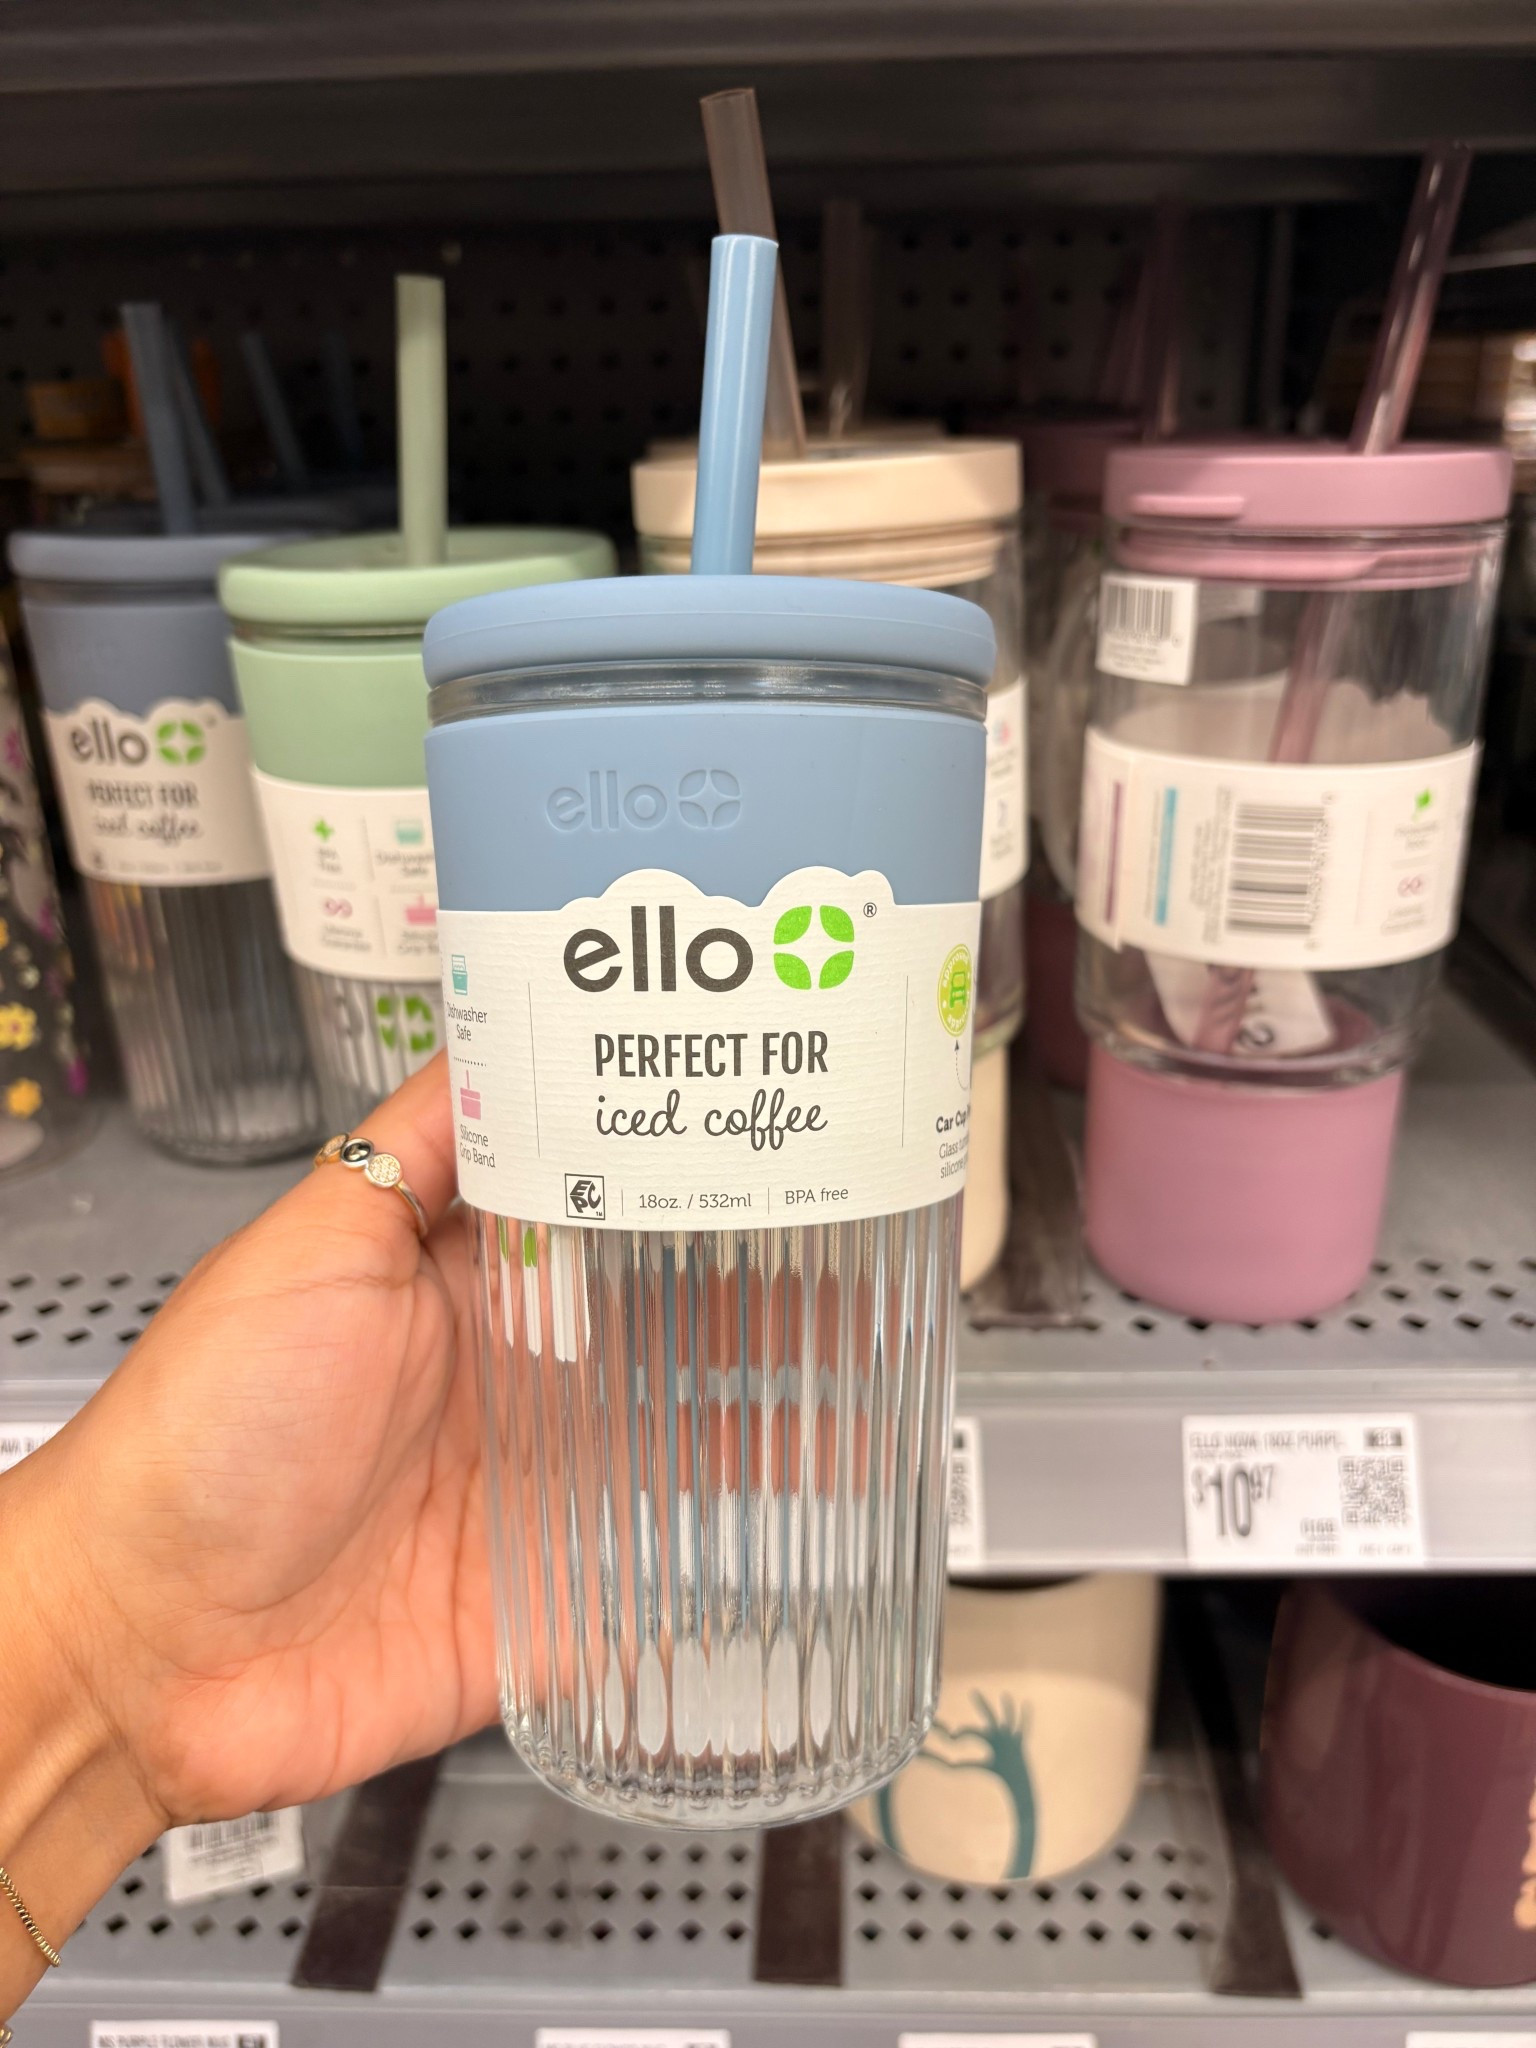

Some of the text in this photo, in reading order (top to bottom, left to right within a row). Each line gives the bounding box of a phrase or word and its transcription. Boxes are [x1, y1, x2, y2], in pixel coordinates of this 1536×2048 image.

[70, 717, 148, 765] ello
[546, 770, 667, 832] ello
[563, 905, 753, 993] ello
[456, 1023, 472, 1042] Safe
[595, 1031, 828, 1077] PERFECT FOR
[596, 1088, 828, 1151] iced coffee
[936, 1116, 954, 1133] Car
[460, 1123, 489, 1147] Silicone
[472, 1147, 496, 1168] Band
[939, 1142, 958, 1159] Glass
[639, 1194, 682, 1209] 18oz.
[699, 1193, 752, 1209] 532ml
[785, 1187, 849, 1205] BPA free
